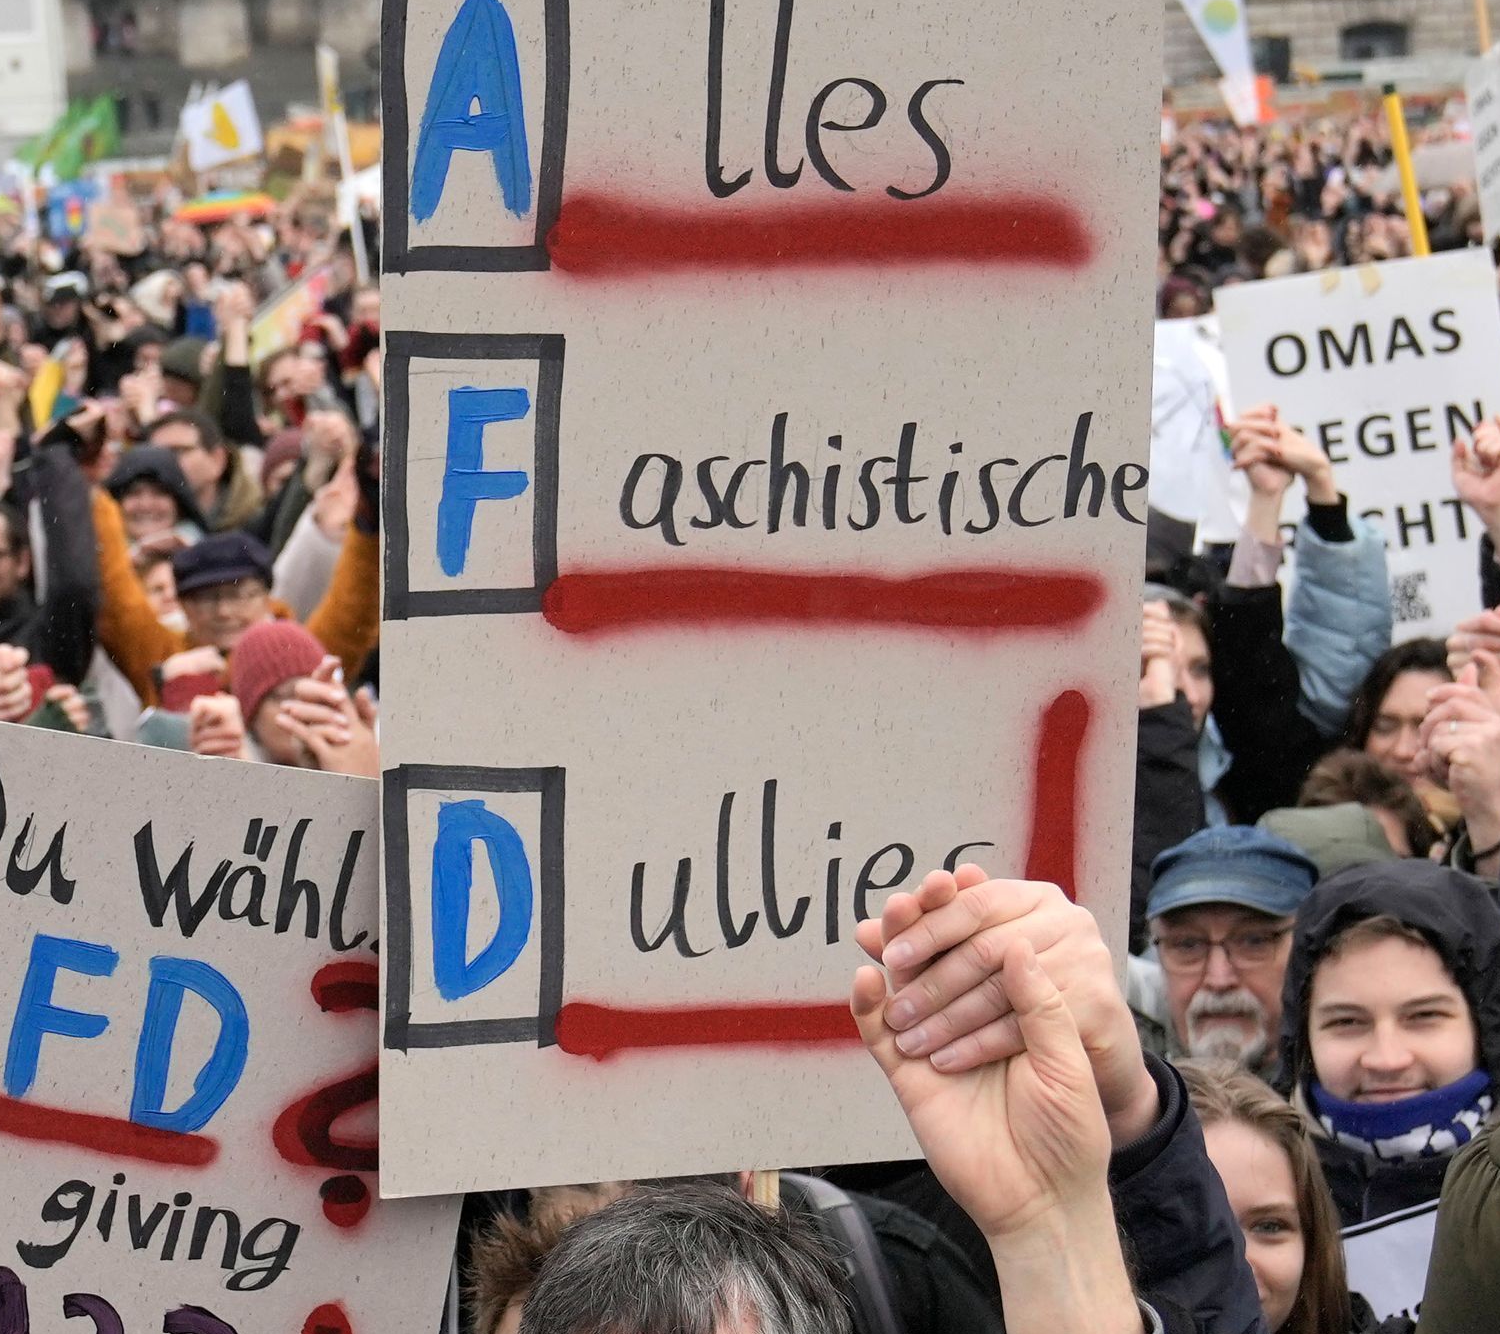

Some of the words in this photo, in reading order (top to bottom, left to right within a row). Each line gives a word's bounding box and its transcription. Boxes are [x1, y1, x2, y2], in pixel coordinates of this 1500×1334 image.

[1265, 308, 1463, 378] OMAS
[1292, 397, 1485, 465] EGEN
[133, 816, 380, 955] wähl
[16, 1172, 302, 1293] giving
